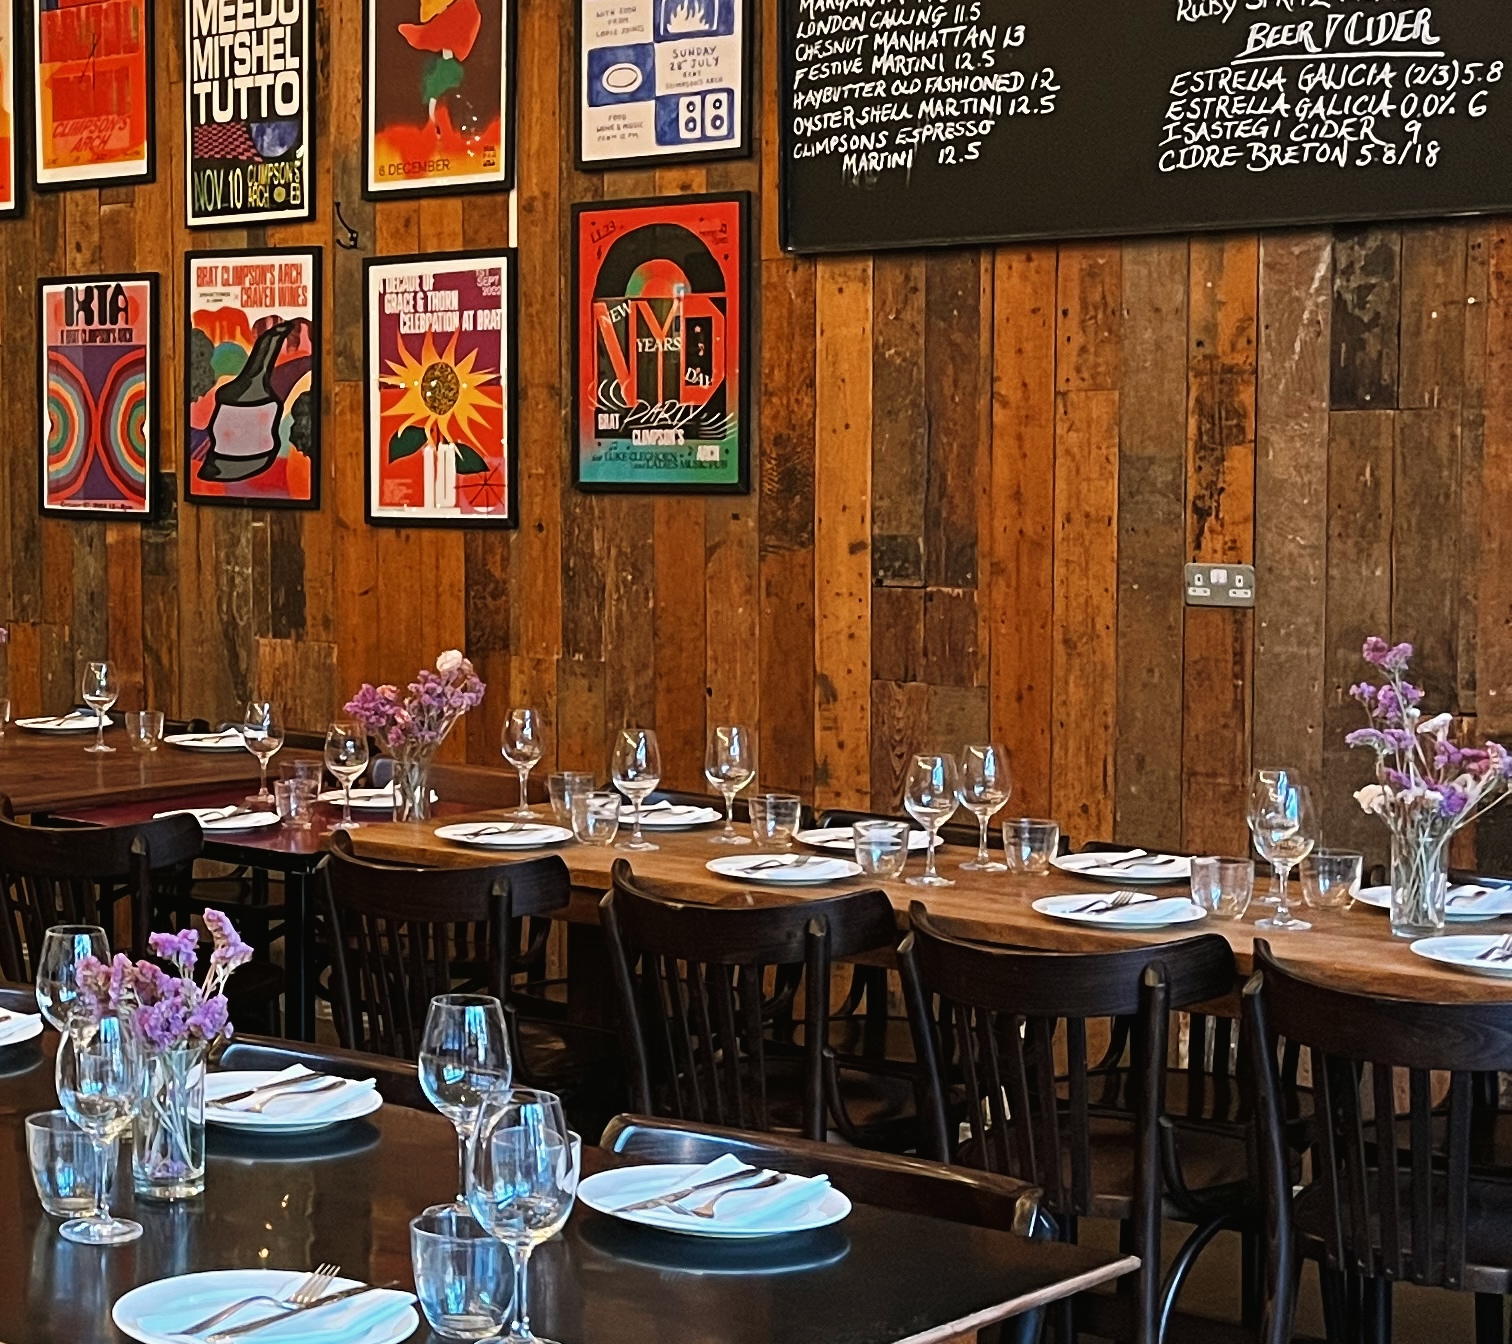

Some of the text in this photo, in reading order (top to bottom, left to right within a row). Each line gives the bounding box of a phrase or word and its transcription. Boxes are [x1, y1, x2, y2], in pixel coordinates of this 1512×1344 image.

[796, 2, 981, 39] LONDON CALLING 11.5
[192, 25, 301, 82] MITSHEL
[672, 44, 717, 59] SUNDAY
[795, 24, 1026, 62] CHESNUT MANHATTAN 13
[690, 55, 720, 68] JULY
[794, 49, 995, 90] FESTIVE MARTINI 12.5
[1169, 59, 1504, 96] ESTRELLA GALICIA (2/3) 5.8
[193, 70, 301, 125] TUTTO
[793, 67, 1061, 109] HAYBUTTER OLD FASHIONED 12
[918, 94, 1002, 119] MARTINI
[1008, 94, 1056, 115] 12.5
[1165, 92, 1291, 121] ESTRELLA
[1294, 90, 1397, 122] GALICIA
[1468, 90, 1488, 117] 6
[793, 119, 995, 159] CLIMPSONS ESPRESSO
[1158, 116, 1422, 147] ISASTEGI CIDER 9
[378, 158, 451, 177] 6 DECEMBER
[842, 141, 982, 176] MARTINI 12.5
[1158, 144, 1244, 172] CIDRE
[1246, 140, 1348, 172] BRETON
[278, 262, 303, 285] ARCH
[386, 275, 420, 292] DECADE
[64, 282, 129, 327] IXTA
[240, 285, 275, 308] CRAVEN
[278, 285, 308, 307] WINES
[384, 291, 415, 314] GRACE
[427, 289, 459, 311] THORN
[399, 310, 460, 334] CELEBRATION
[462, 309, 475, 331] AT
[637, 337, 682, 353] YEARS
